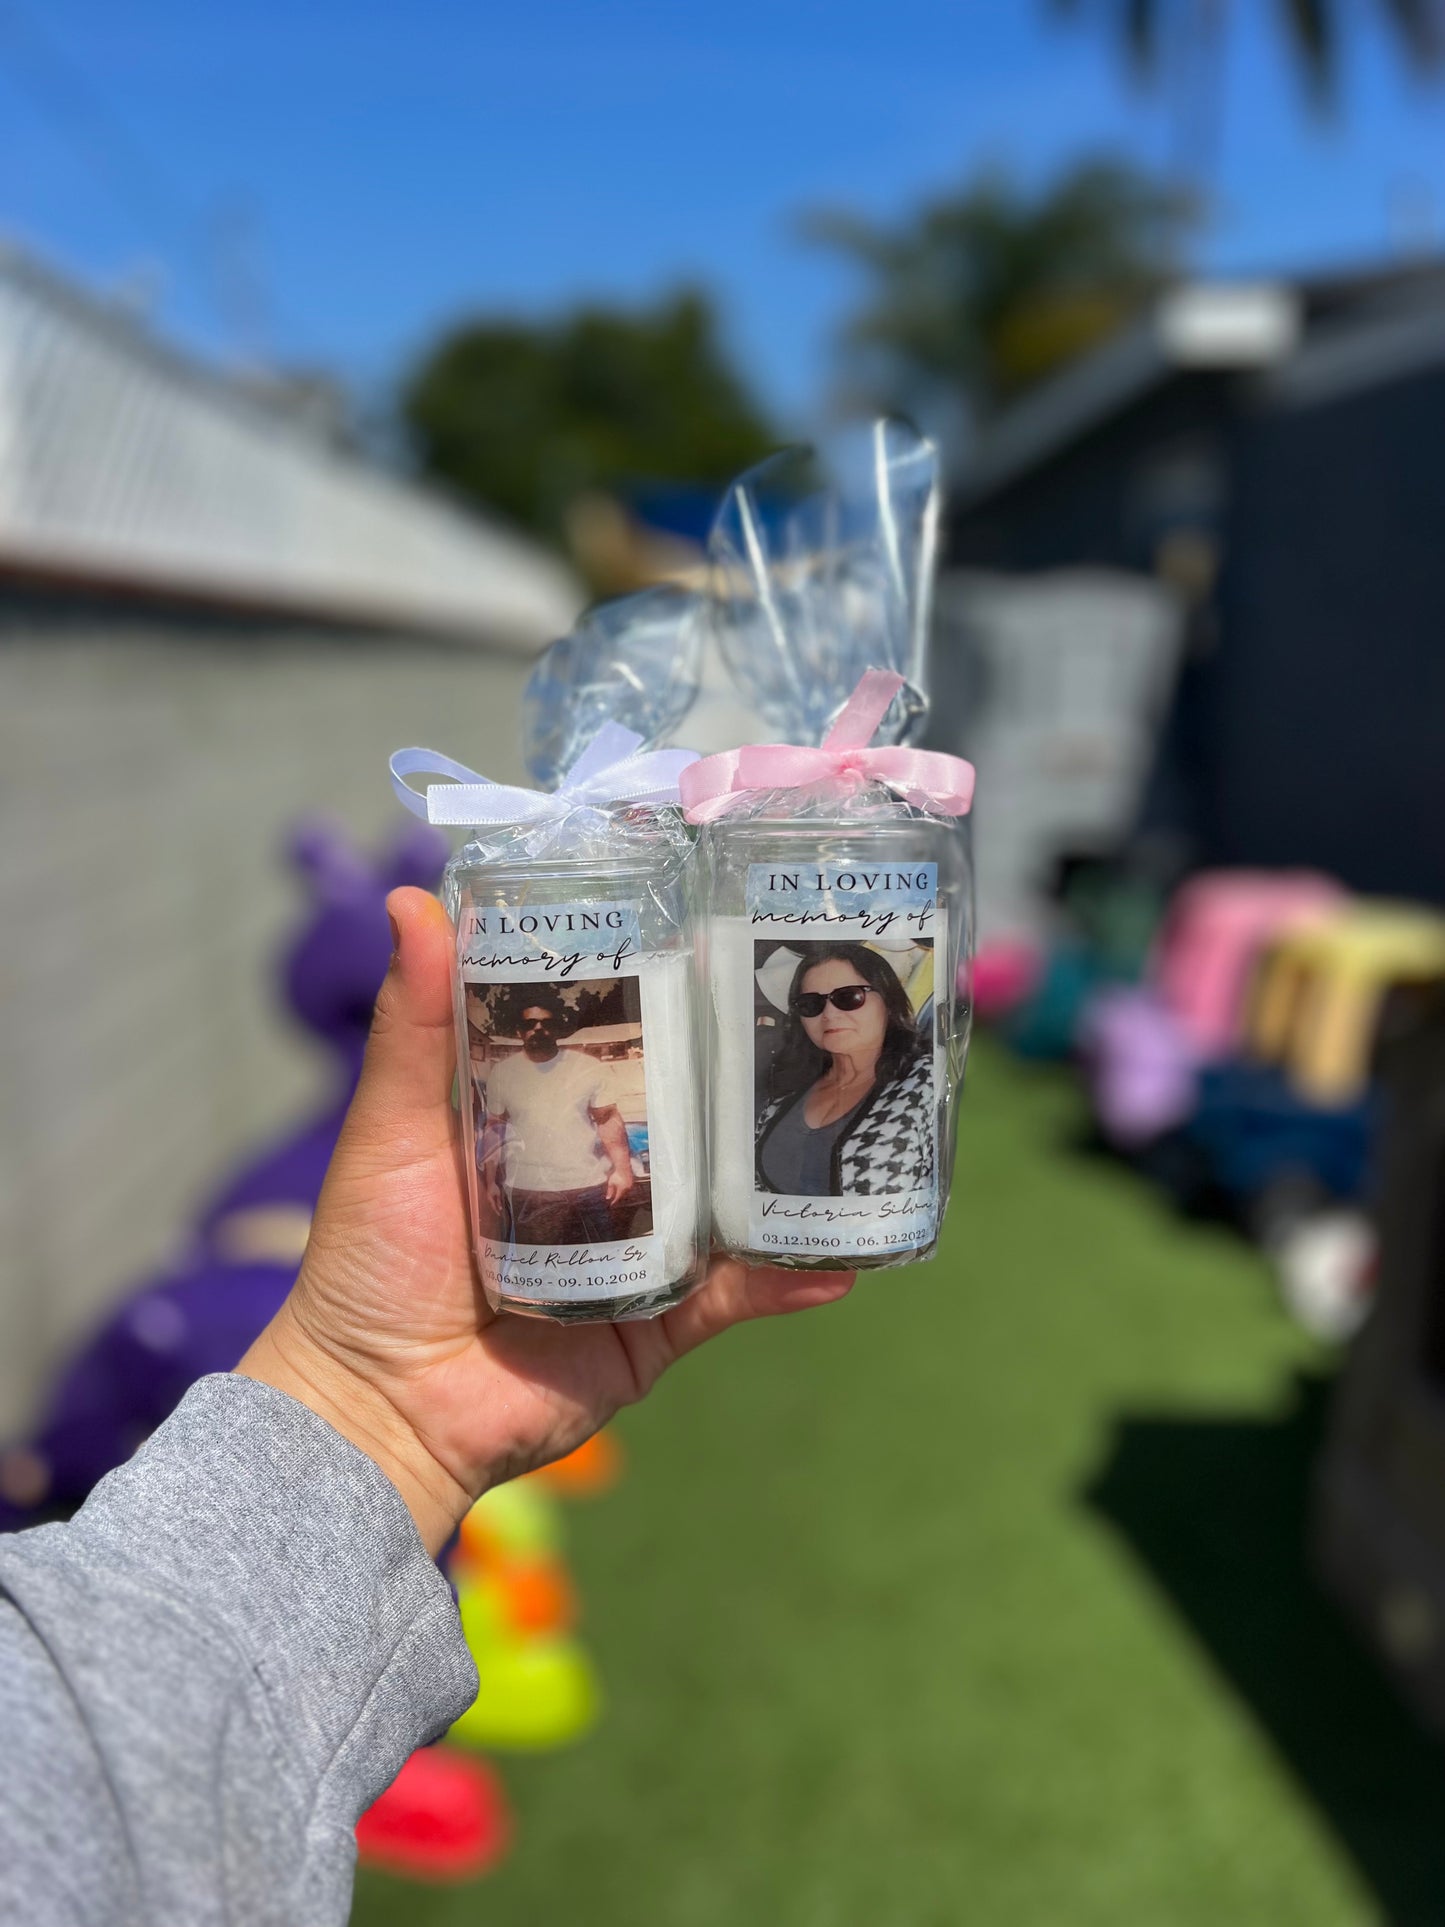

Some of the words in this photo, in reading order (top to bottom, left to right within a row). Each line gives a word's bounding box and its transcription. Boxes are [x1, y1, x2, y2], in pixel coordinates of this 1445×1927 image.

[768, 874, 800, 891] IN
[816, 872, 928, 891] LOVING
[469, 917, 487, 935] IN
[500, 911, 624, 934] LOVING
[752, 910, 900, 935] memory
[906, 899, 935, 931] of
[462, 951, 587, 976] memory
[596, 937, 637, 971] of
[762, 1199, 872, 1221] Victoria
[878, 1197, 933, 1218] Silva
[762, 1233, 840, 1247] 03.12.1960
[544, 1250, 614, 1269] Rillon
[622, 1245, 648, 1262] Sr
